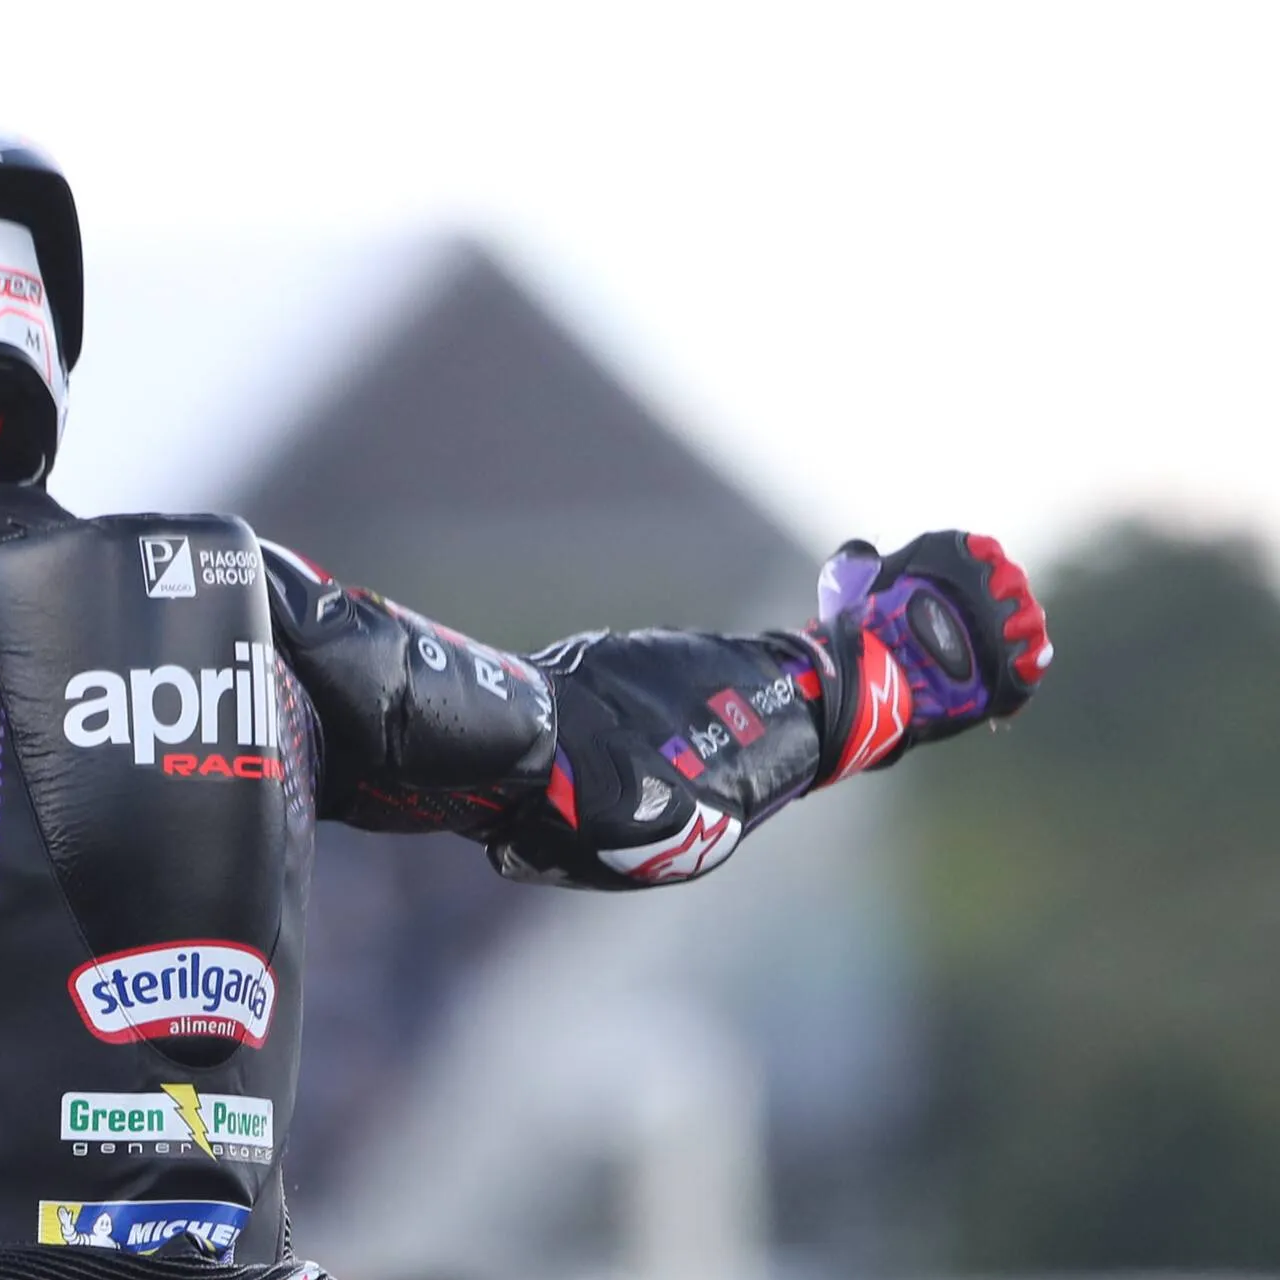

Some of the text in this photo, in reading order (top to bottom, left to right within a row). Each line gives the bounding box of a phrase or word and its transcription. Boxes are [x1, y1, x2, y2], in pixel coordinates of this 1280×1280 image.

[199, 550, 257, 568] PIAGGIO
[202, 568, 256, 585] GROUP
[92, 951, 267, 1020] sterilgarda
[169, 1016, 237, 1038] alimenti
[69, 1099, 268, 1138] Green Power
